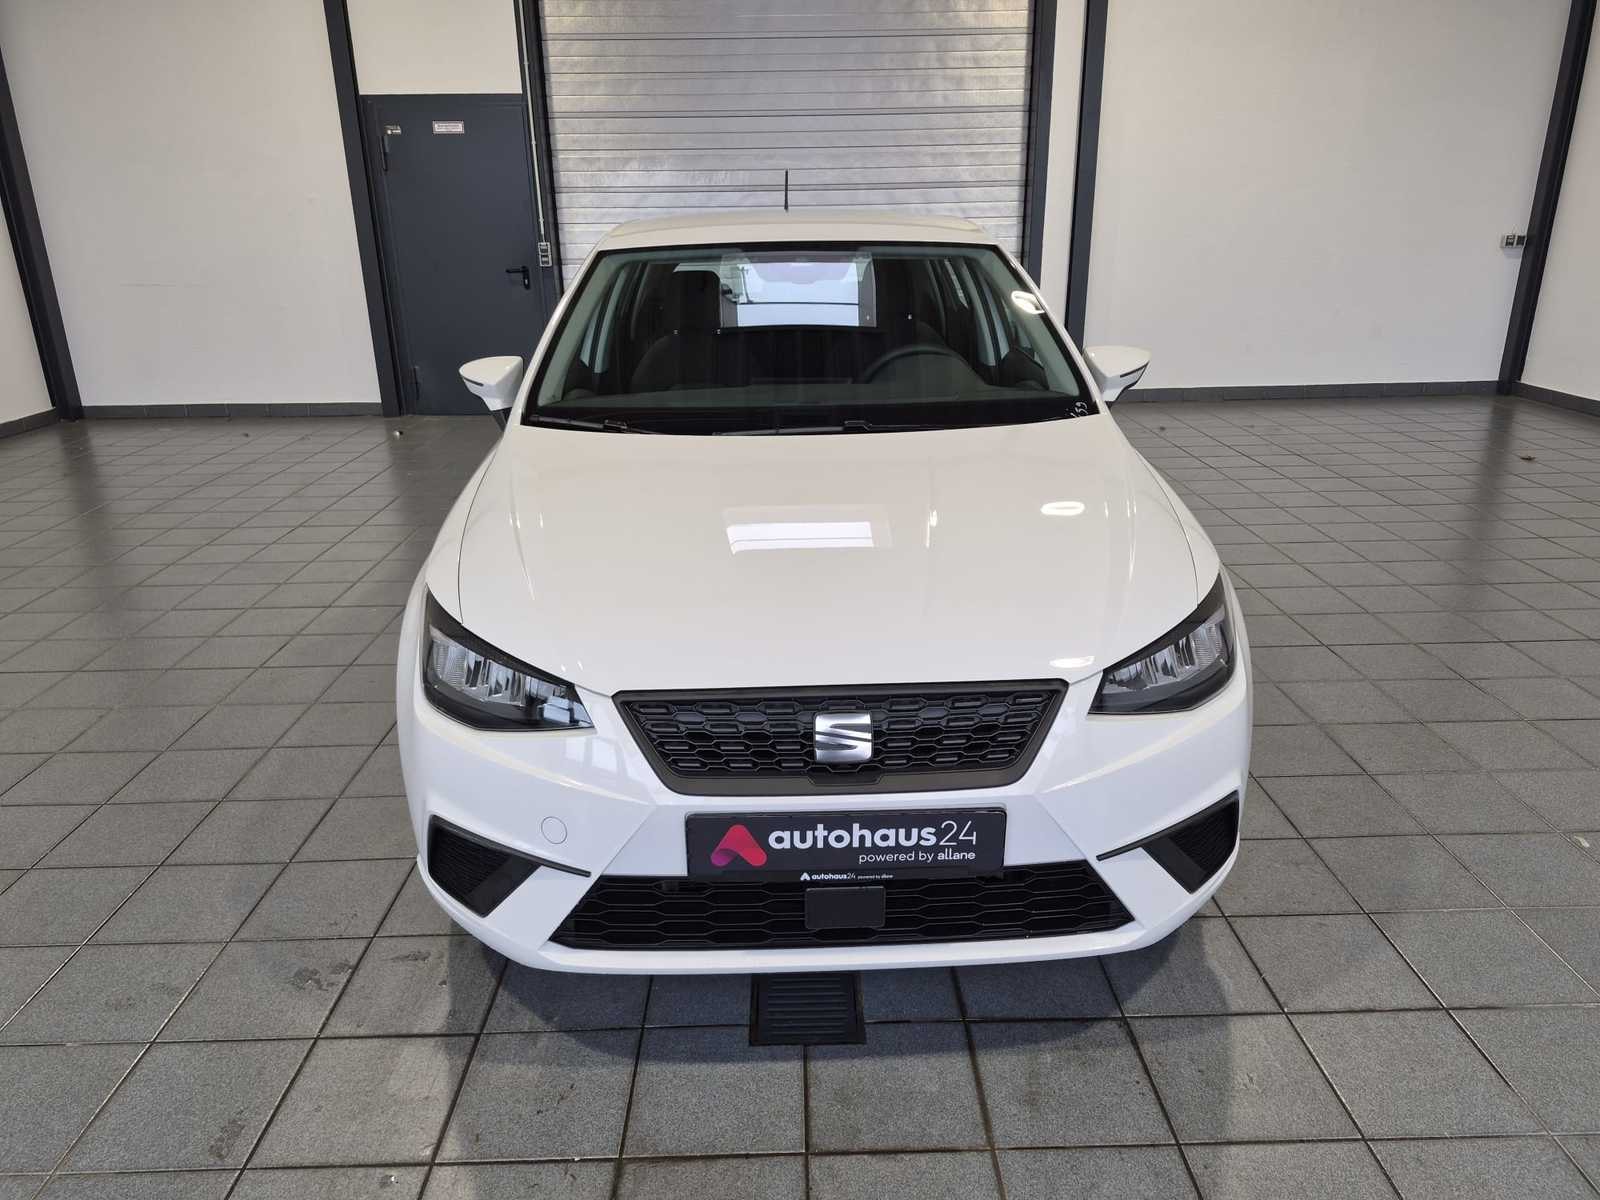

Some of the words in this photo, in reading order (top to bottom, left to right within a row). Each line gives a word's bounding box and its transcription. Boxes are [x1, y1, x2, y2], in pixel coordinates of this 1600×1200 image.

[768, 820, 977, 850] autohaus24
[858, 850, 915, 865] powered
[918, 850, 935, 864] by
[936, 847, 977, 861] allane
